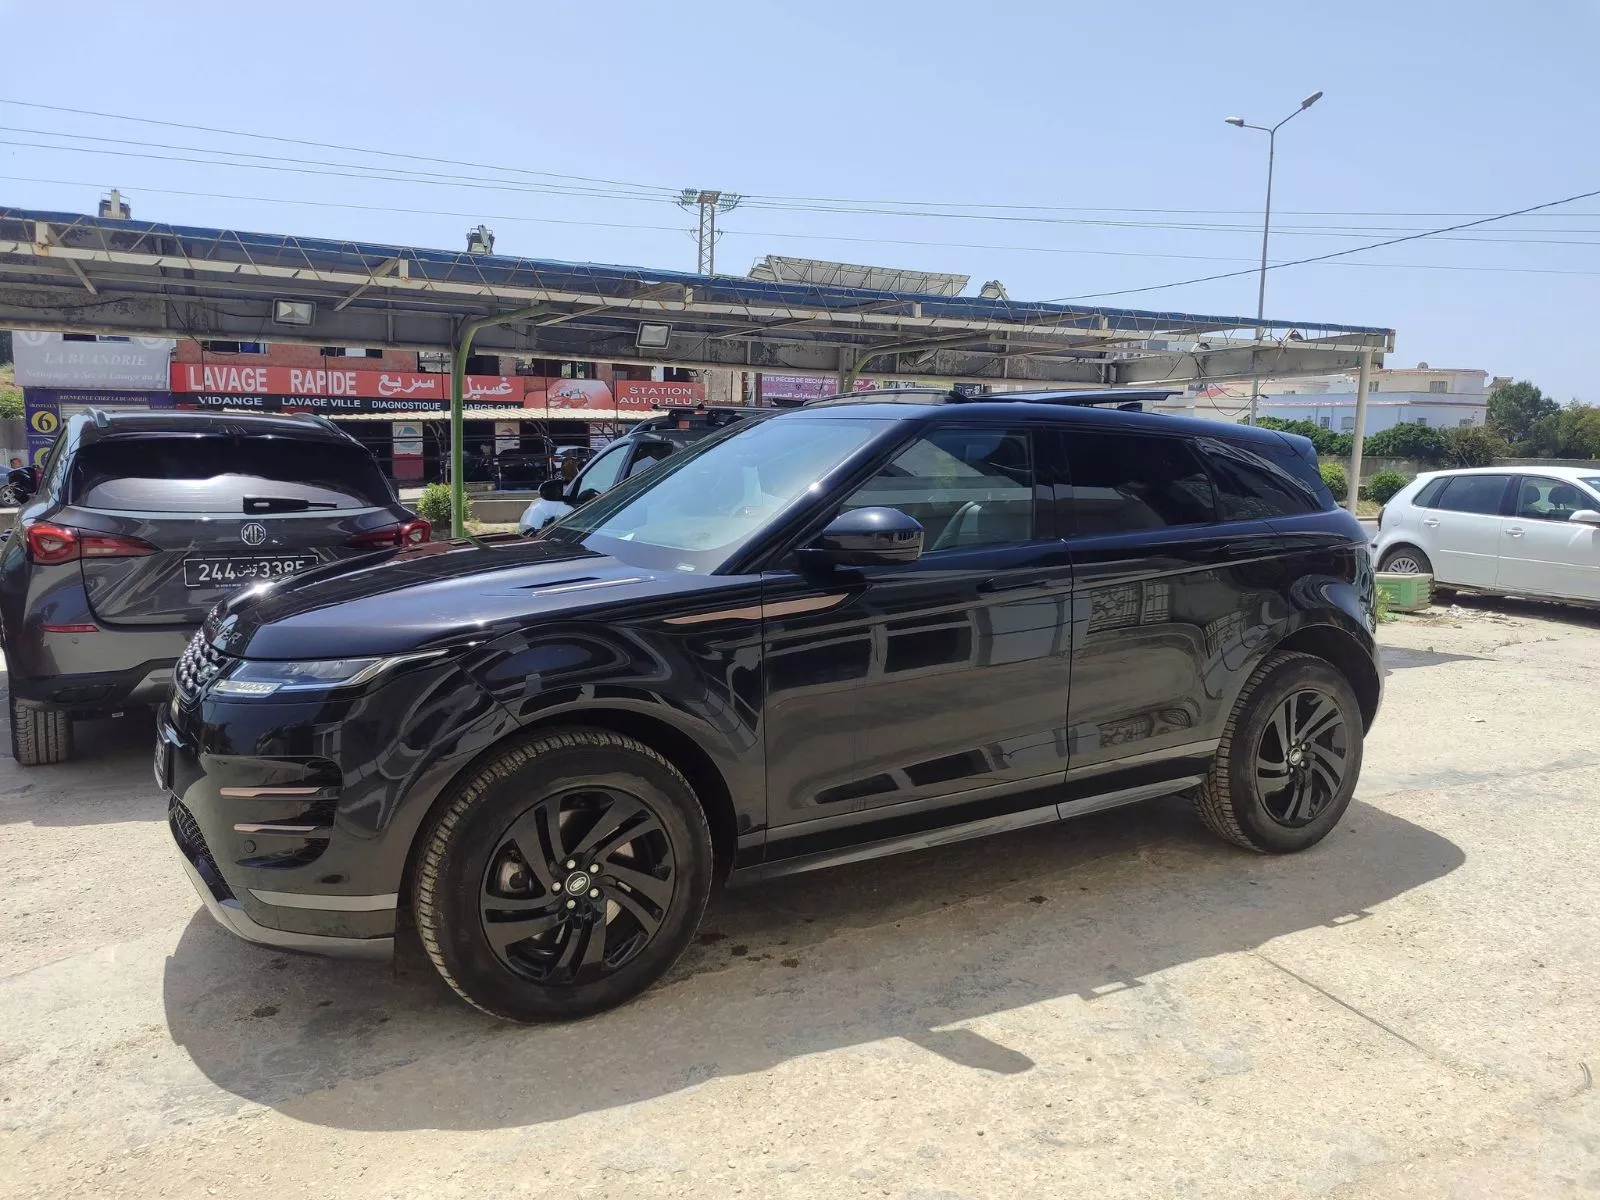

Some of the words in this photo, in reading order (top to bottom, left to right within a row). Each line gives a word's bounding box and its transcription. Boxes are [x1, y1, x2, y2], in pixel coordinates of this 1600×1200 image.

[44, 353, 65, 364] LA
[68, 353, 148, 366] BUANDRIE
[189, 366, 268, 392] LAVAGE
[290, 369, 357, 395] RAPIDE
[378, 374, 435, 396] سريع
[462, 376, 513, 400] غسيل
[629, 386, 692, 395] STATION
[198, 395, 263, 406] VIDANGE
[282, 397, 328, 407] LAVAGE
[329, 398, 361, 408] VILLE
[371, 399, 442, 410] DIAGNOSTIQUE
[619, 396, 661, 405] AUTO
[38, 412, 52, 431] 6
[243, 524, 265, 544] MG
[198, 562, 236, 581] 244
[236, 563, 258, 577] تونس
